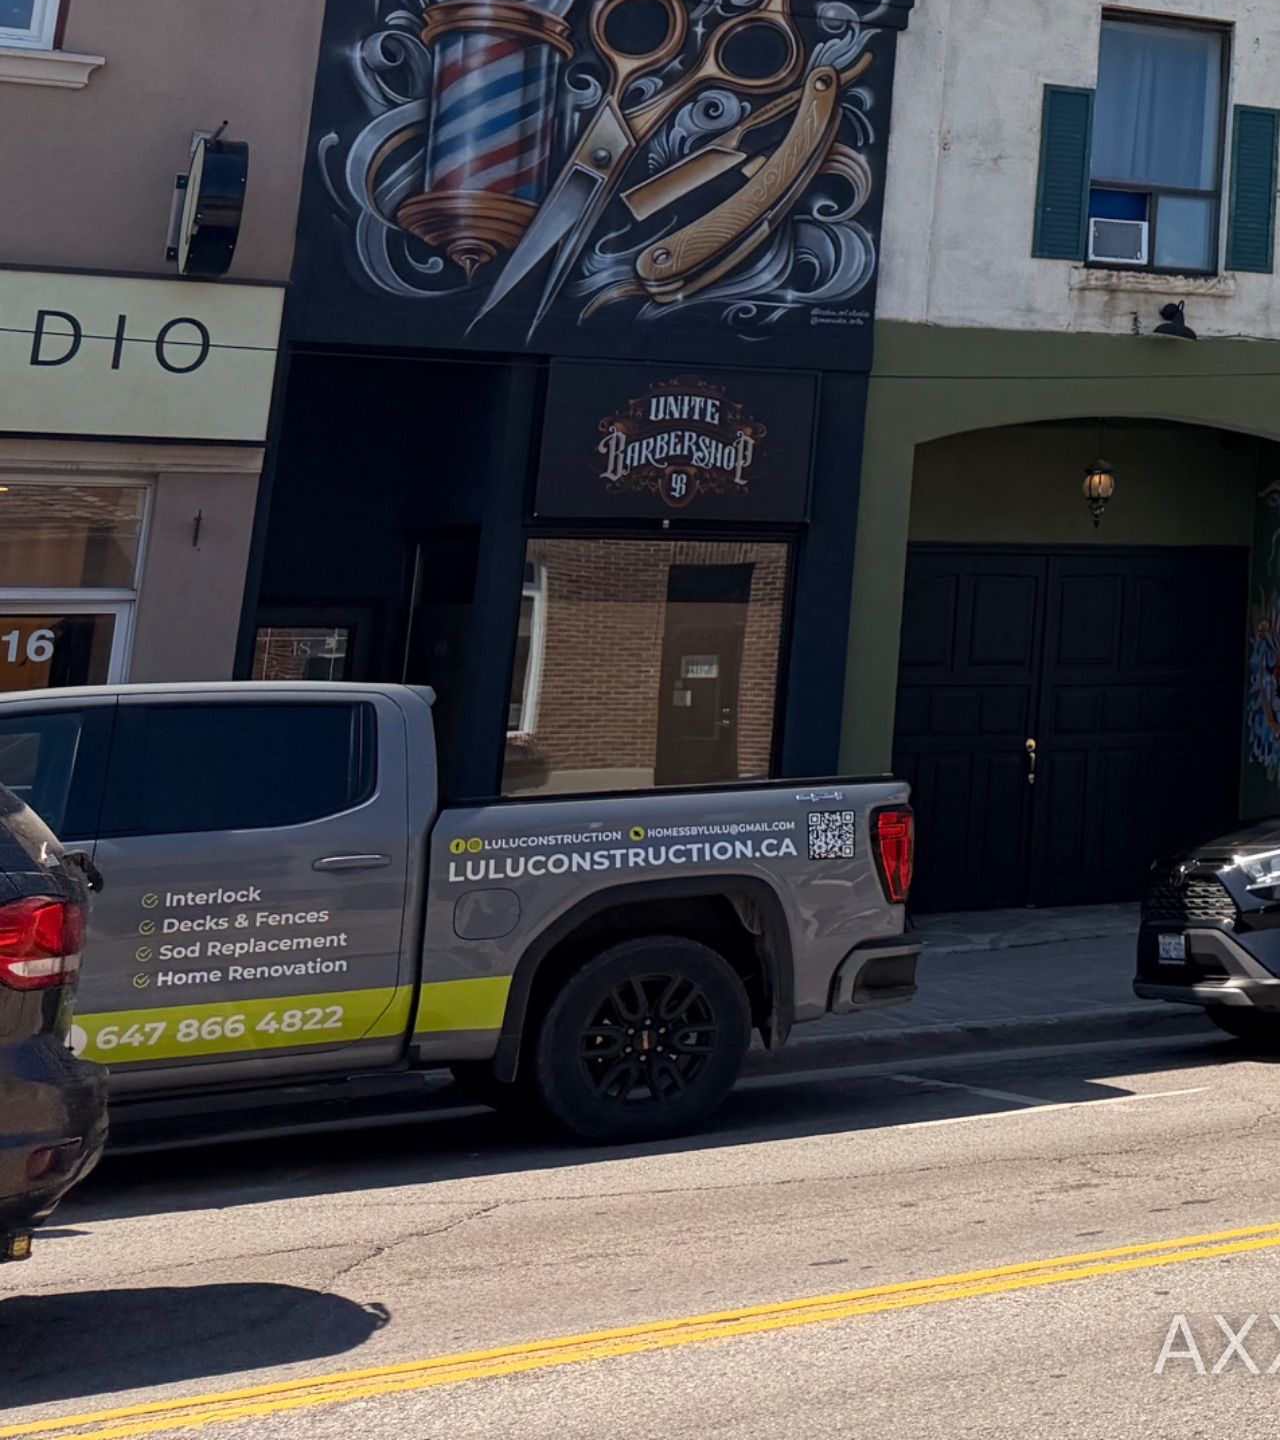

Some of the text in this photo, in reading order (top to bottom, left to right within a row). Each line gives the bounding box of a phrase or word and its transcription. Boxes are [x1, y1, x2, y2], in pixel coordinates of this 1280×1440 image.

[30, 309, 210, 374] DIO
[649, 395, 720, 425] UNITE
[598, 425, 755, 485] BARBERSHOP
[1, 628, 55, 663] 16
[485, 820, 796, 850] LULUCONSTRUCTION HOMESSBYLULU@GMAIL.COM
[448, 838, 798, 882] LULUCONSTRUCTION.CA
[165, 886, 261, 908] Interlock
[162, 910, 329, 934] Decks & Fences
[159, 932, 348, 960] Sod Replacement
[157, 958, 348, 987] Home Renovation
[96, 1006, 344, 1049] 647 866 4822
